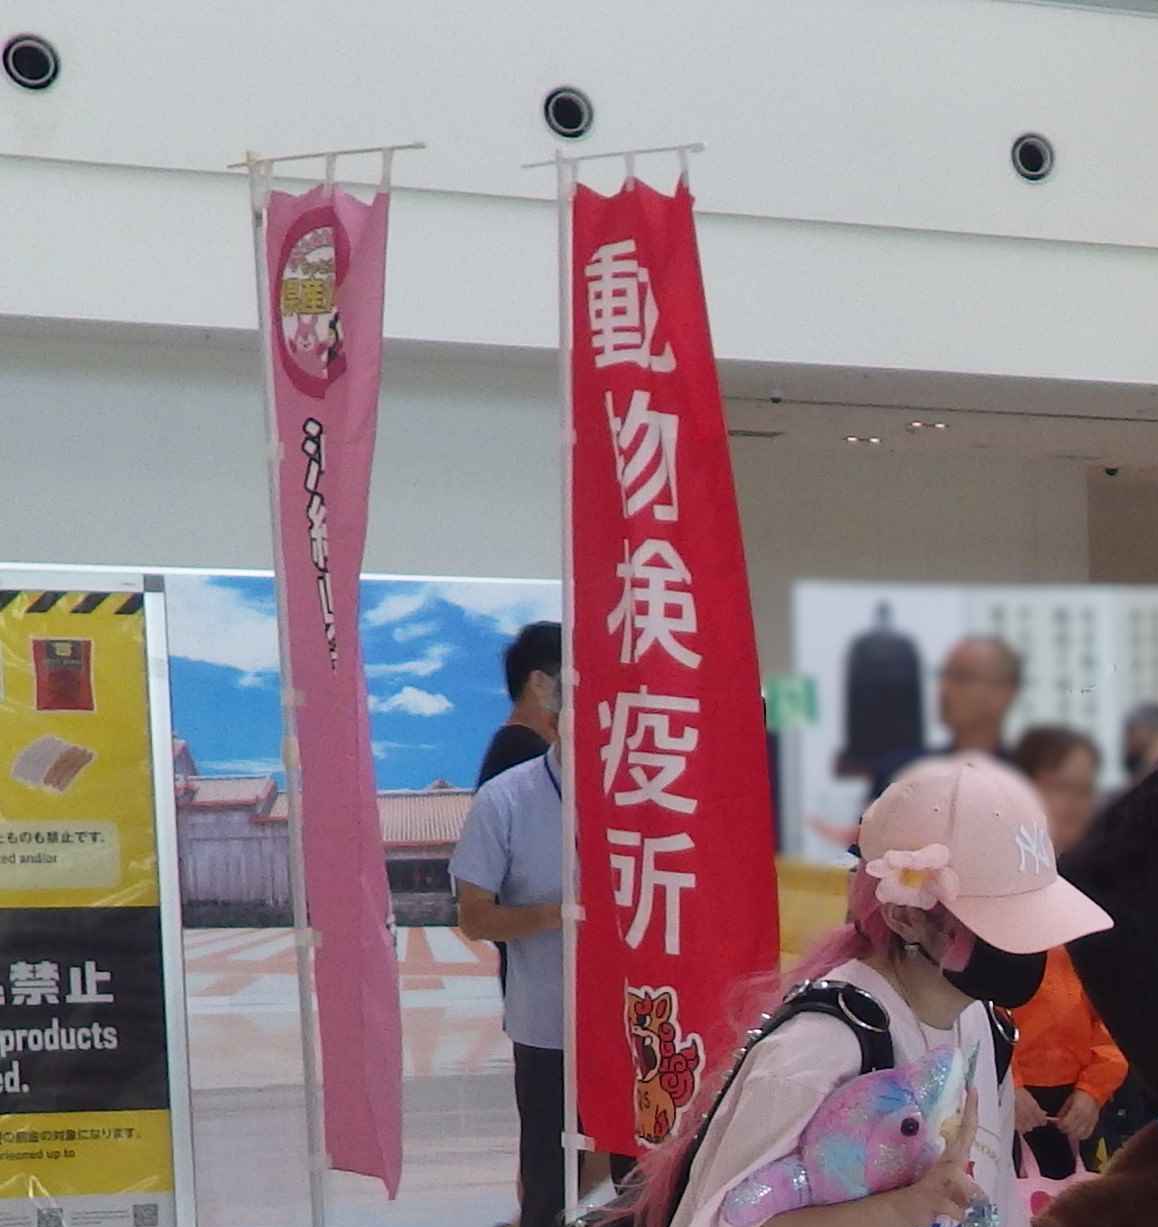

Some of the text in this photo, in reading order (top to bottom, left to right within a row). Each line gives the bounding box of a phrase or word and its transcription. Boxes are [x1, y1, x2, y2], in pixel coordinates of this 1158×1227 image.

[584, 239, 702, 956] 動物検疫所
[0, 960, 115, 1006] 禁止
[0, 1017, 119, 1058] products
[0, 1060, 29, 1094] d.
[46, 1150, 60, 1160] up
[63, 1148, 75, 1158] to
